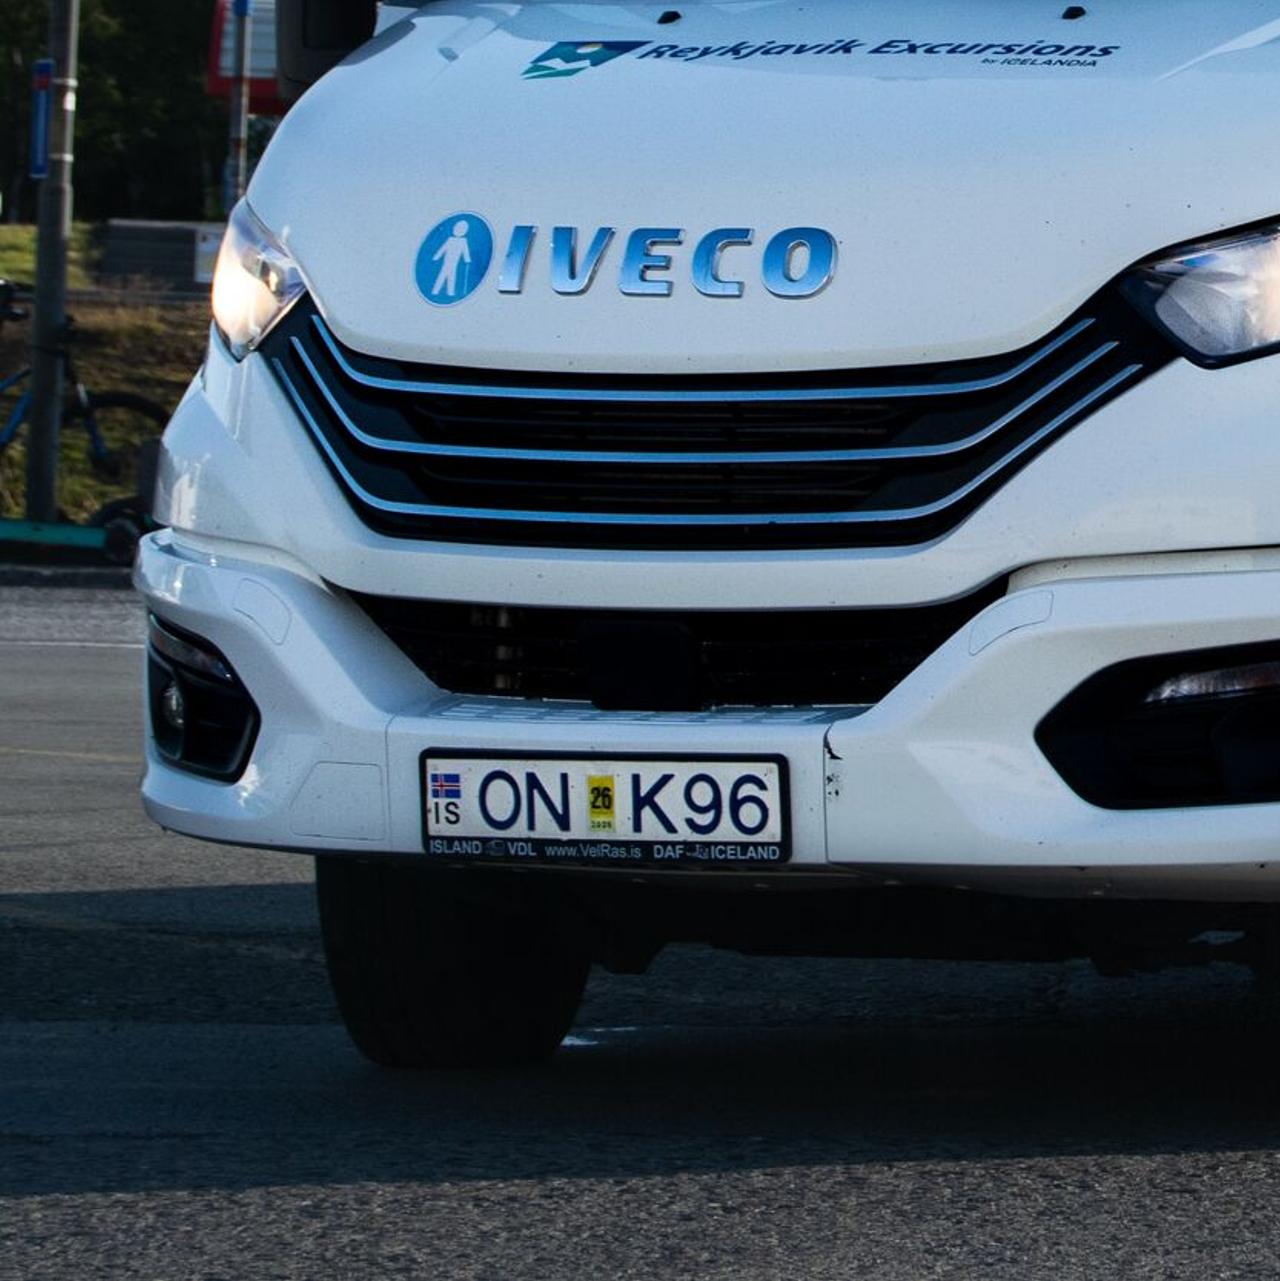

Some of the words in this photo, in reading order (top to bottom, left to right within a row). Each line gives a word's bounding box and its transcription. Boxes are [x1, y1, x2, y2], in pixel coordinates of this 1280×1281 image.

[636, 39, 866, 61] Reykjavik
[868, 39, 1120, 57] Excursions
[999, 58, 1097, 67] ICELANDIA
[498, 225, 839, 297] IVECO
[478, 770, 571, 832] ON
[631, 773, 770, 836] K96
[590, 786, 611, 810] 26
[434, 801, 461, 825] IS
[429, 839, 483, 855] ISLAND
[507, 842, 537, 857] VDL
[653, 844, 685, 860] DAF
[711, 845, 780, 860] ICELAND
